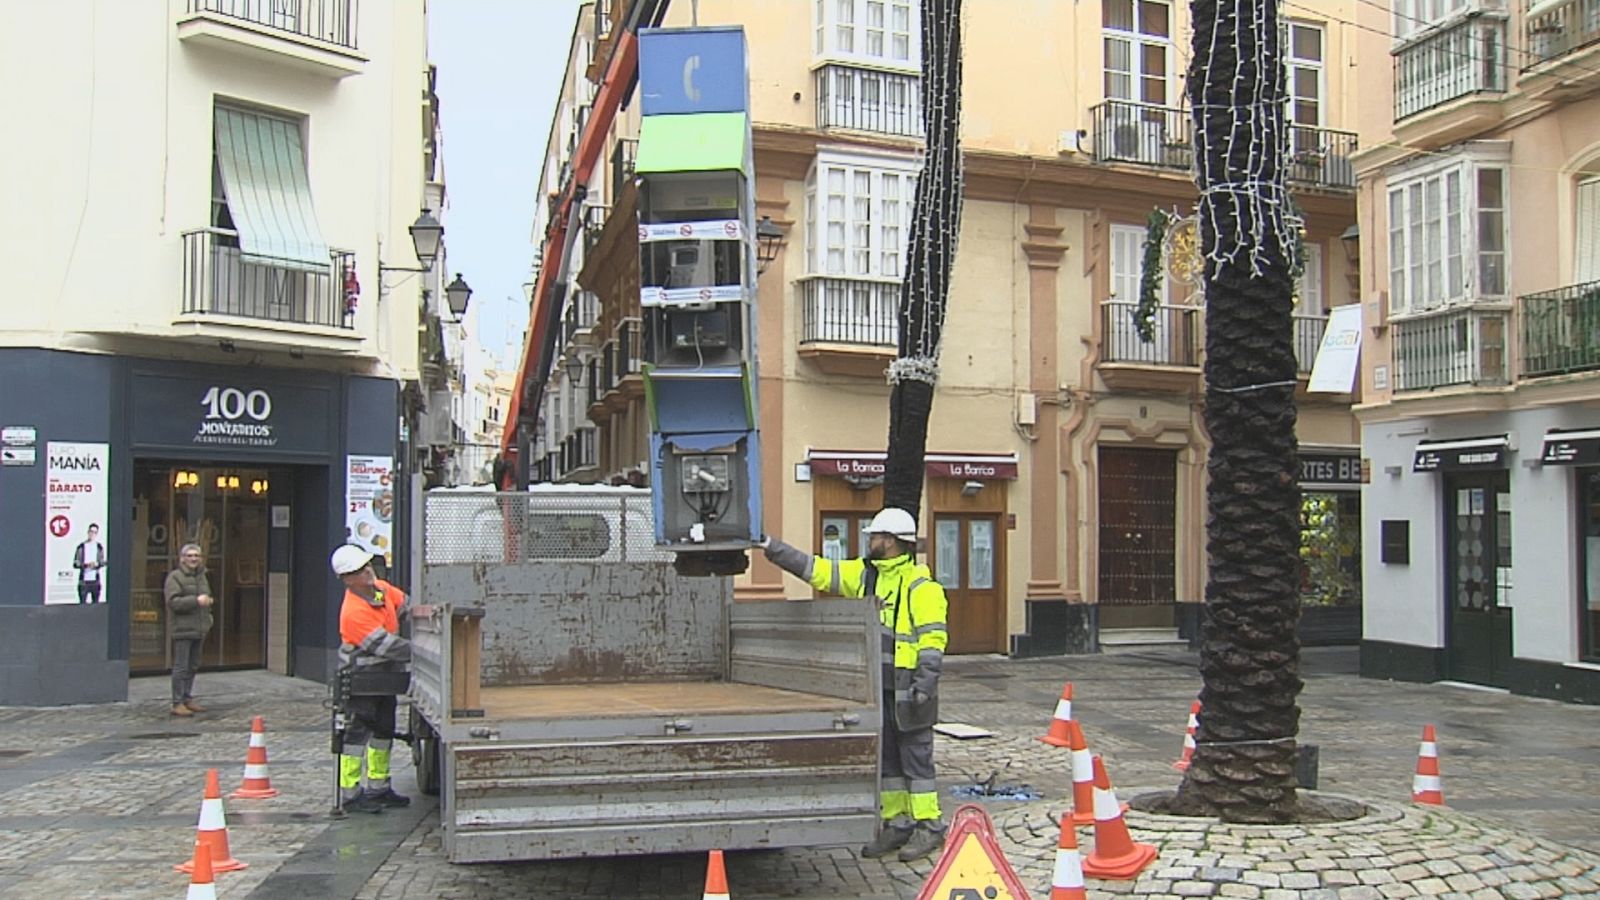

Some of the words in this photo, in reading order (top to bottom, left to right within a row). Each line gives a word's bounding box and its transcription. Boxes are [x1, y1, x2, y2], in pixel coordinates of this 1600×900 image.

[201, 387, 272, 421] 100
[198, 421, 271, 437] MONTADITOS
[50, 453, 101, 471] MANÍA
[836, 460, 849, 473] La
[950, 463, 962, 476] La
[49, 484, 93, 493] BARATO
